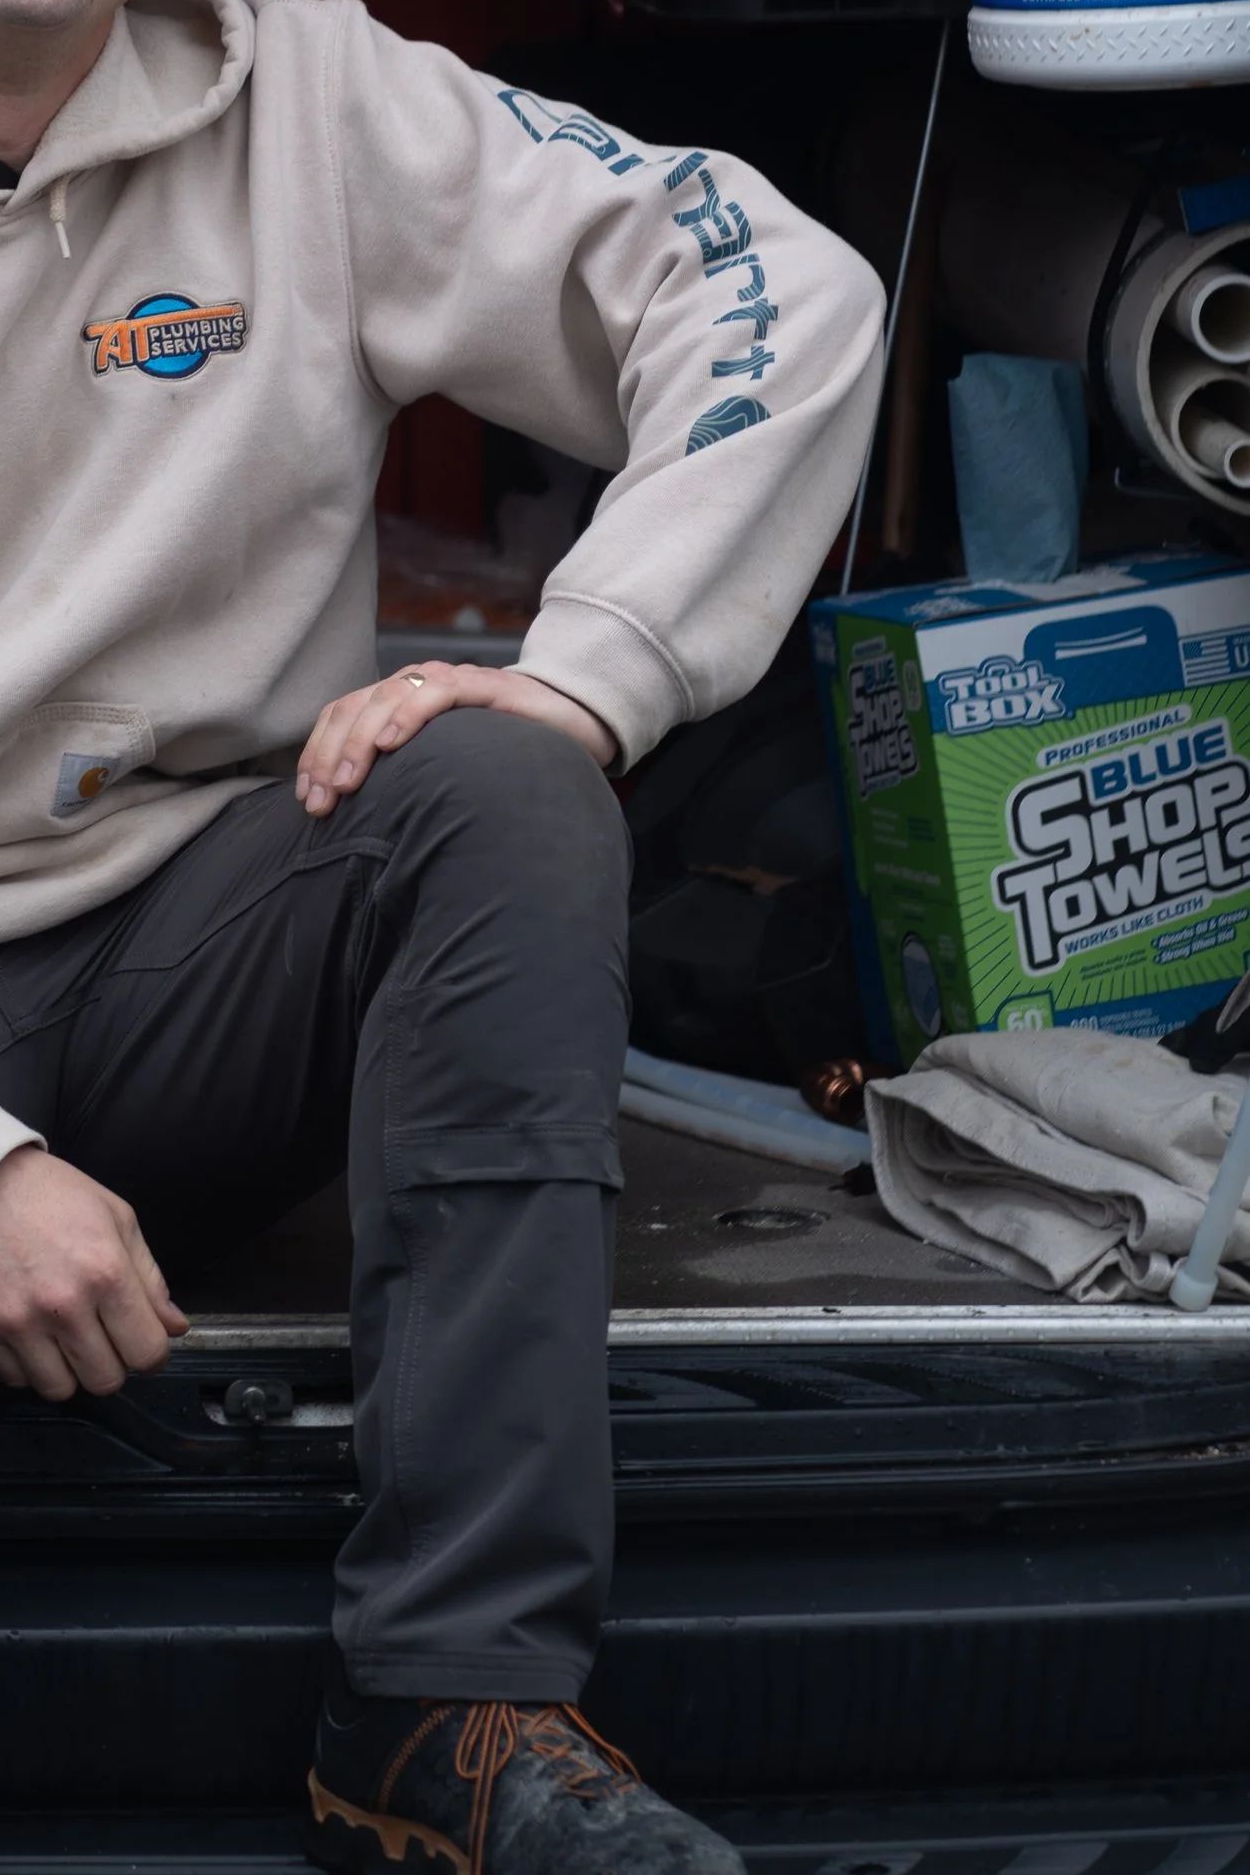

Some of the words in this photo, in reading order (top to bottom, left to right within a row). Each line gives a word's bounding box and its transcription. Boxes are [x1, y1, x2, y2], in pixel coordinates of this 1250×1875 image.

[149, 316, 244, 341] PLUMBING
[151, 332, 242, 356] SERVICES
[851, 668, 902, 736] SHOP
[944, 666, 1048, 700] TOOL
[951, 684, 1064, 729] BOX
[850, 727, 917, 794] TOWELS
[1045, 709, 1186, 766] PROFESSIONAL
[1091, 724, 1227, 801] BLUE
[1018, 763, 1247, 880] SHOP
[1065, 927, 1118, 954] WORKS
[1121, 915, 1154, 936] LIKE
[1157, 895, 1204, 922] CLOTH
